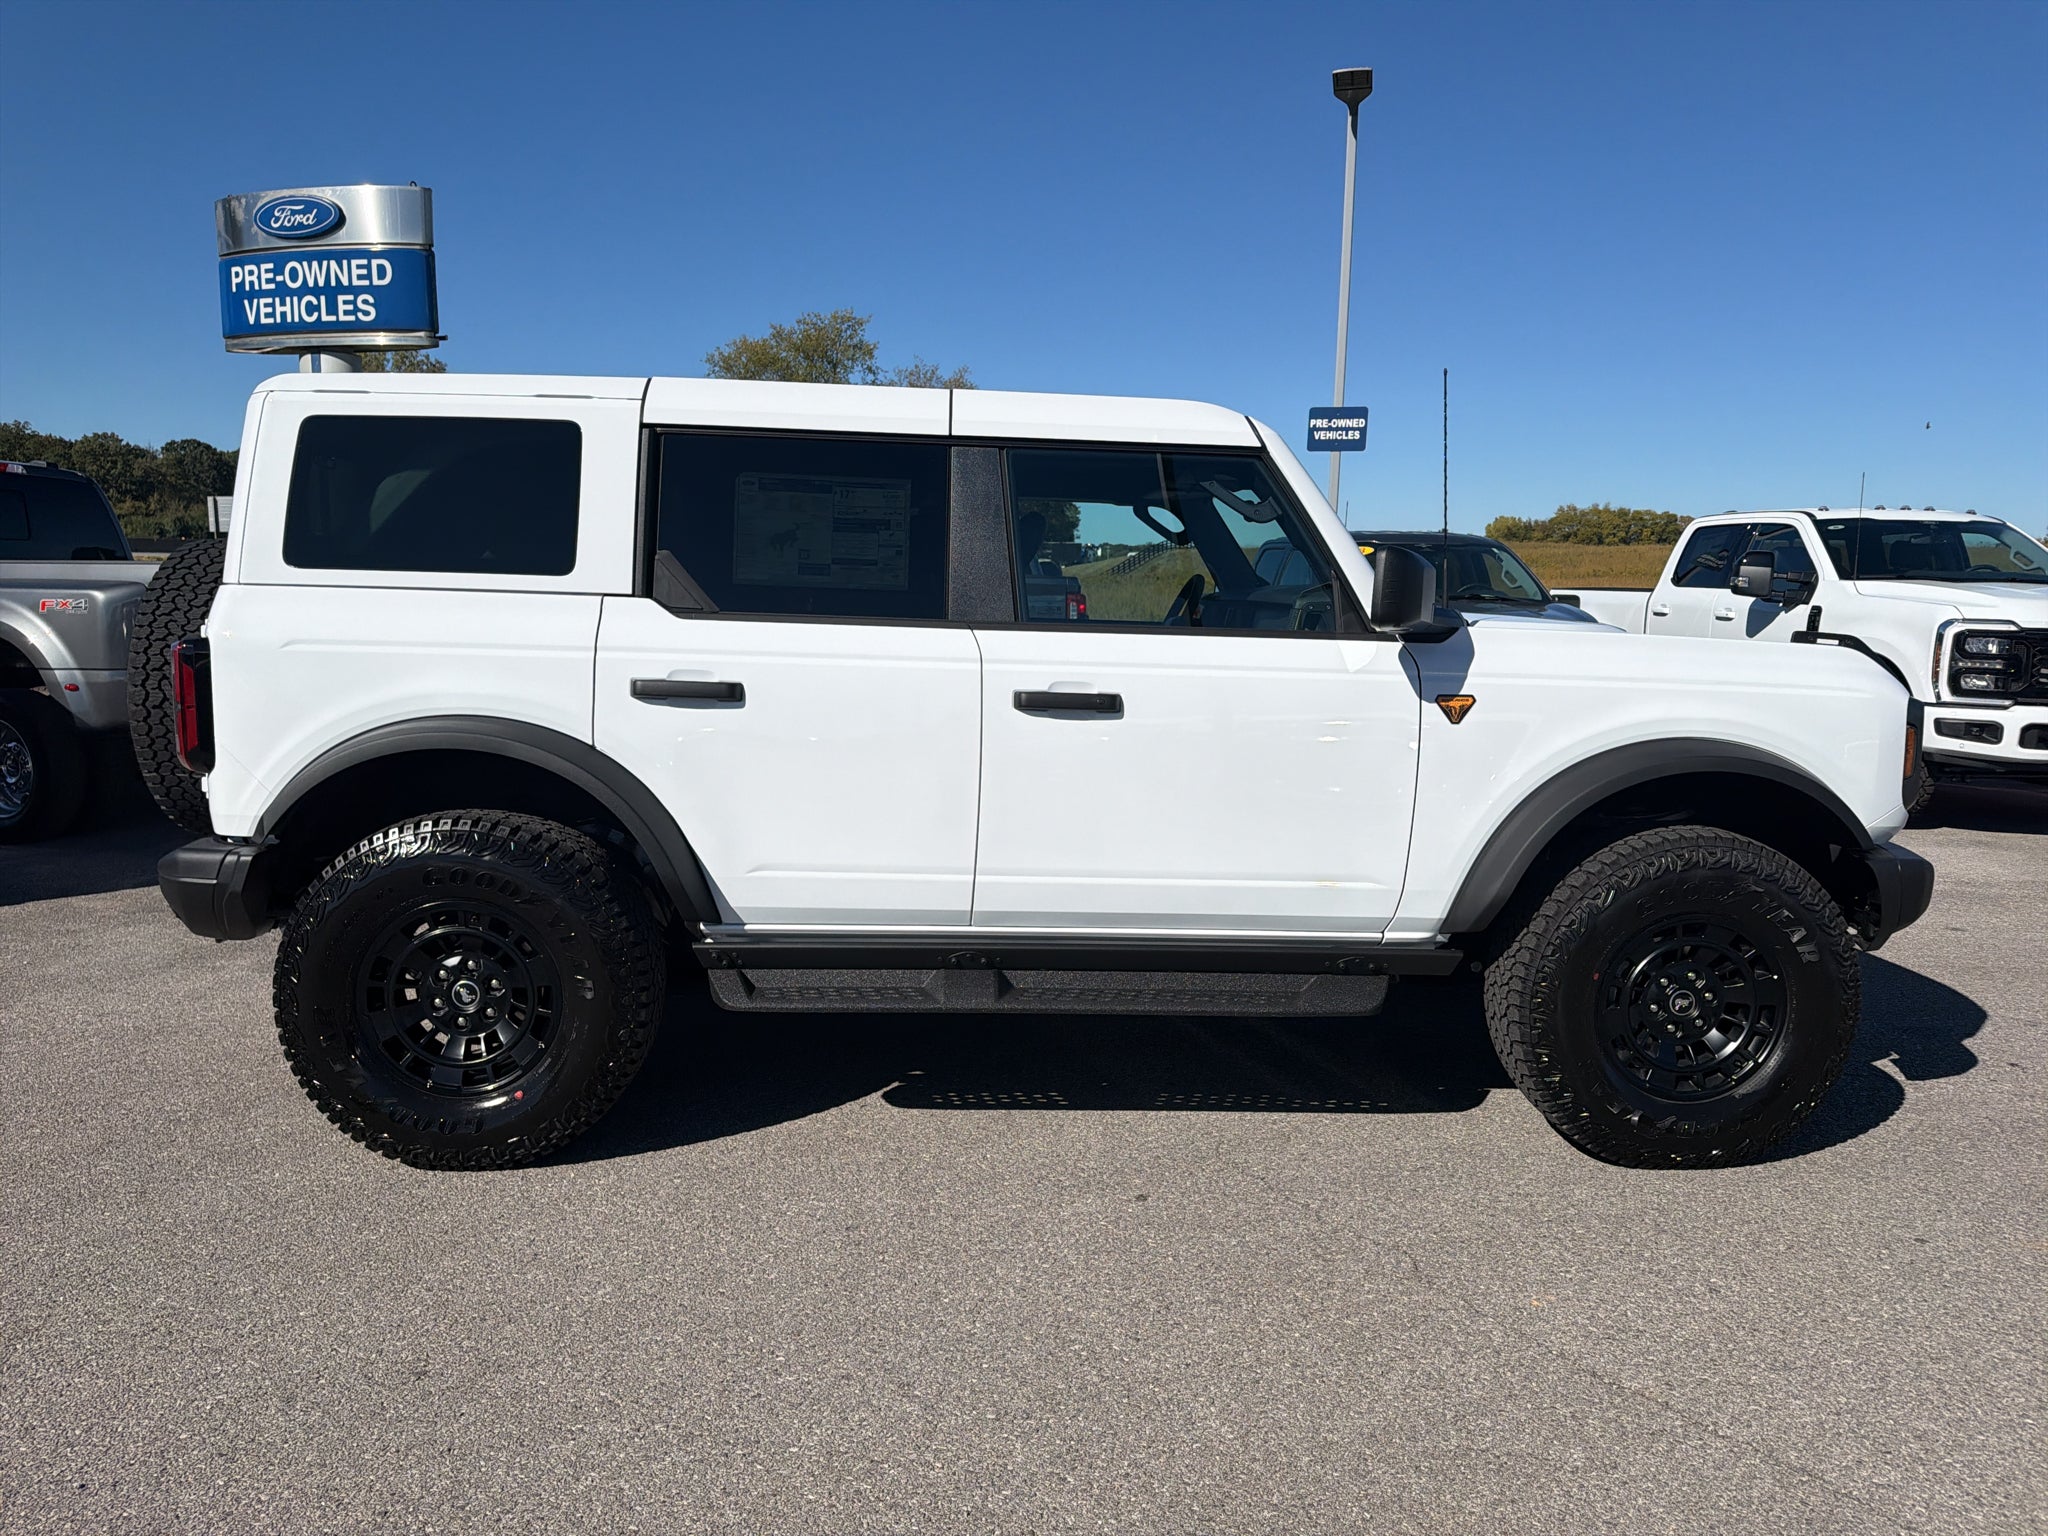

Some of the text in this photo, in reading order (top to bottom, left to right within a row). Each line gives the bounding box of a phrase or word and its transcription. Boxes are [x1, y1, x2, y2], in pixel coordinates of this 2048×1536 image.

[270, 204, 318, 229] Ford
[231, 258, 393, 293] PRE-OWNED
[243, 294, 377, 325] VEHICLES
[1309, 418, 1366, 428] PRE-OWNED
[1313, 430, 1361, 440] VEHICLES
[39, 598, 89, 614] FX4
